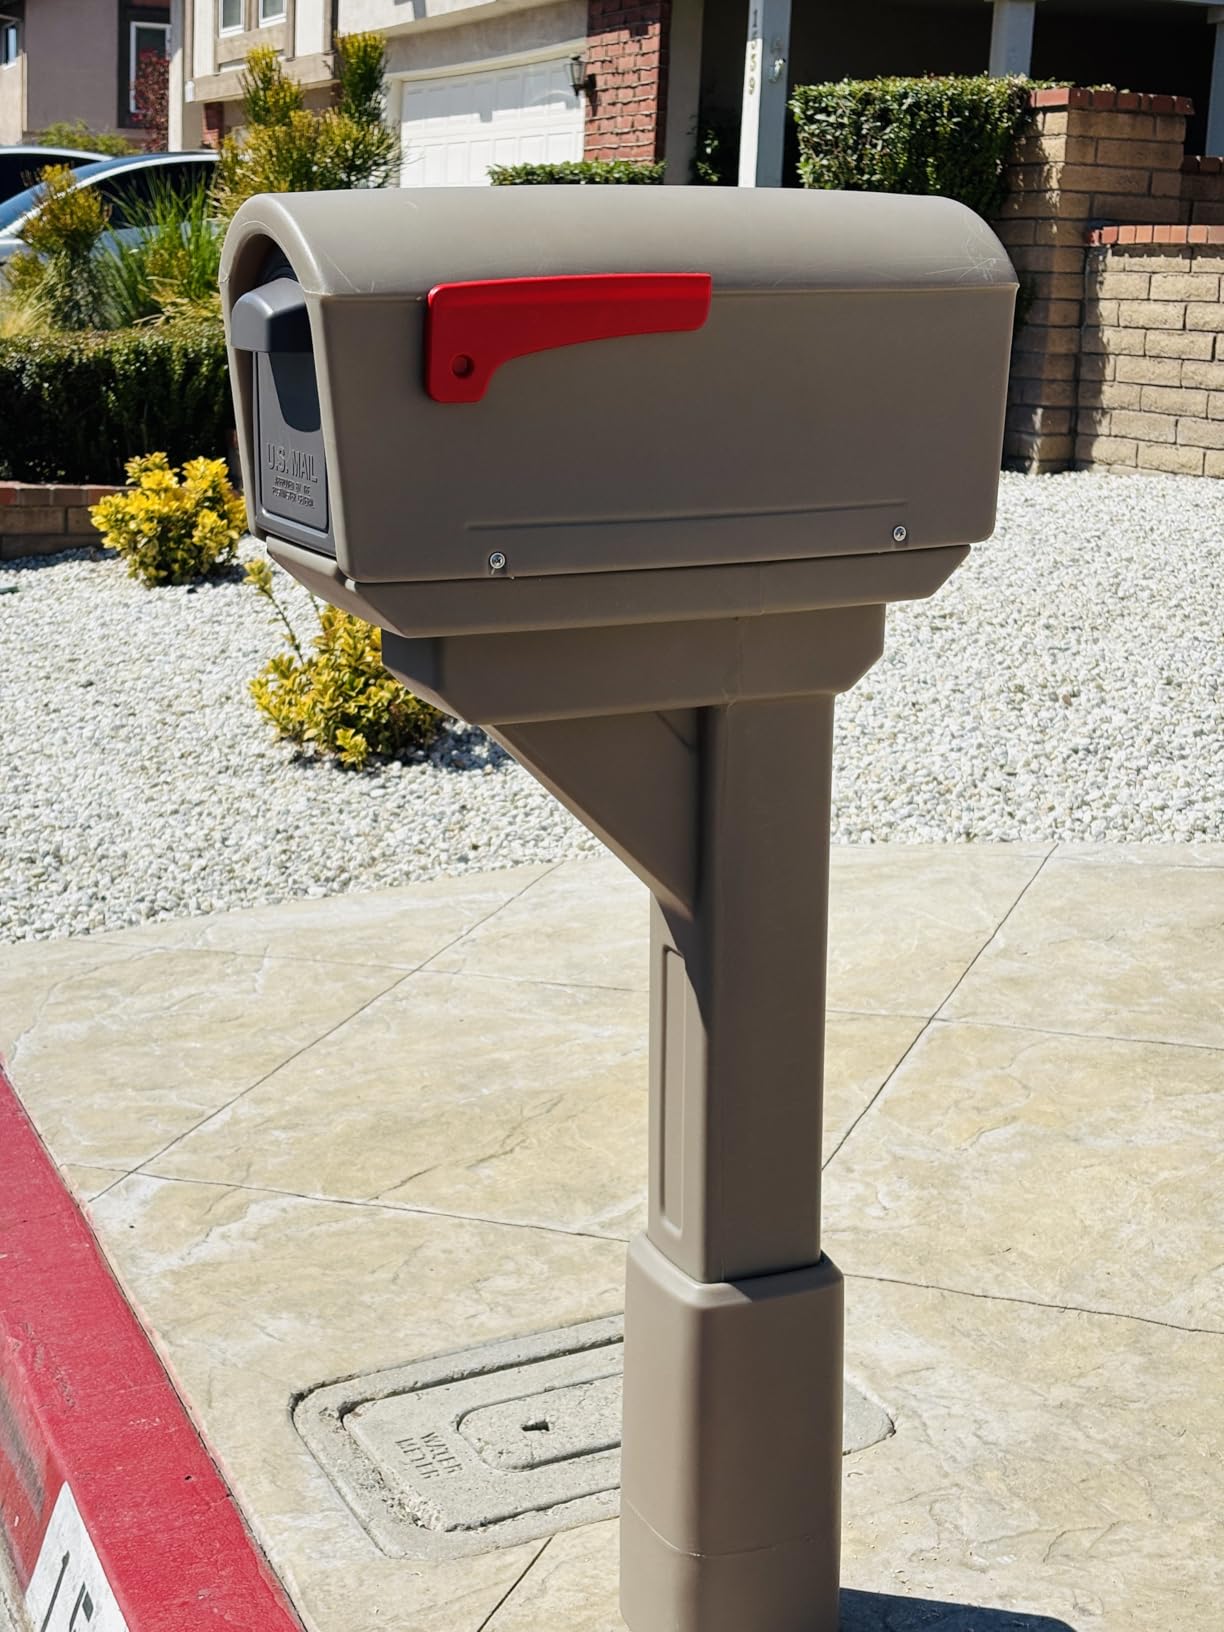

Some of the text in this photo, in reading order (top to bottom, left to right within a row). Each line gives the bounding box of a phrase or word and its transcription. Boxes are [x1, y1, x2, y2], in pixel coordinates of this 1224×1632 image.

[266, 442, 318, 483] U.S. MAIL
[420, 1431, 463, 1475] WATER
